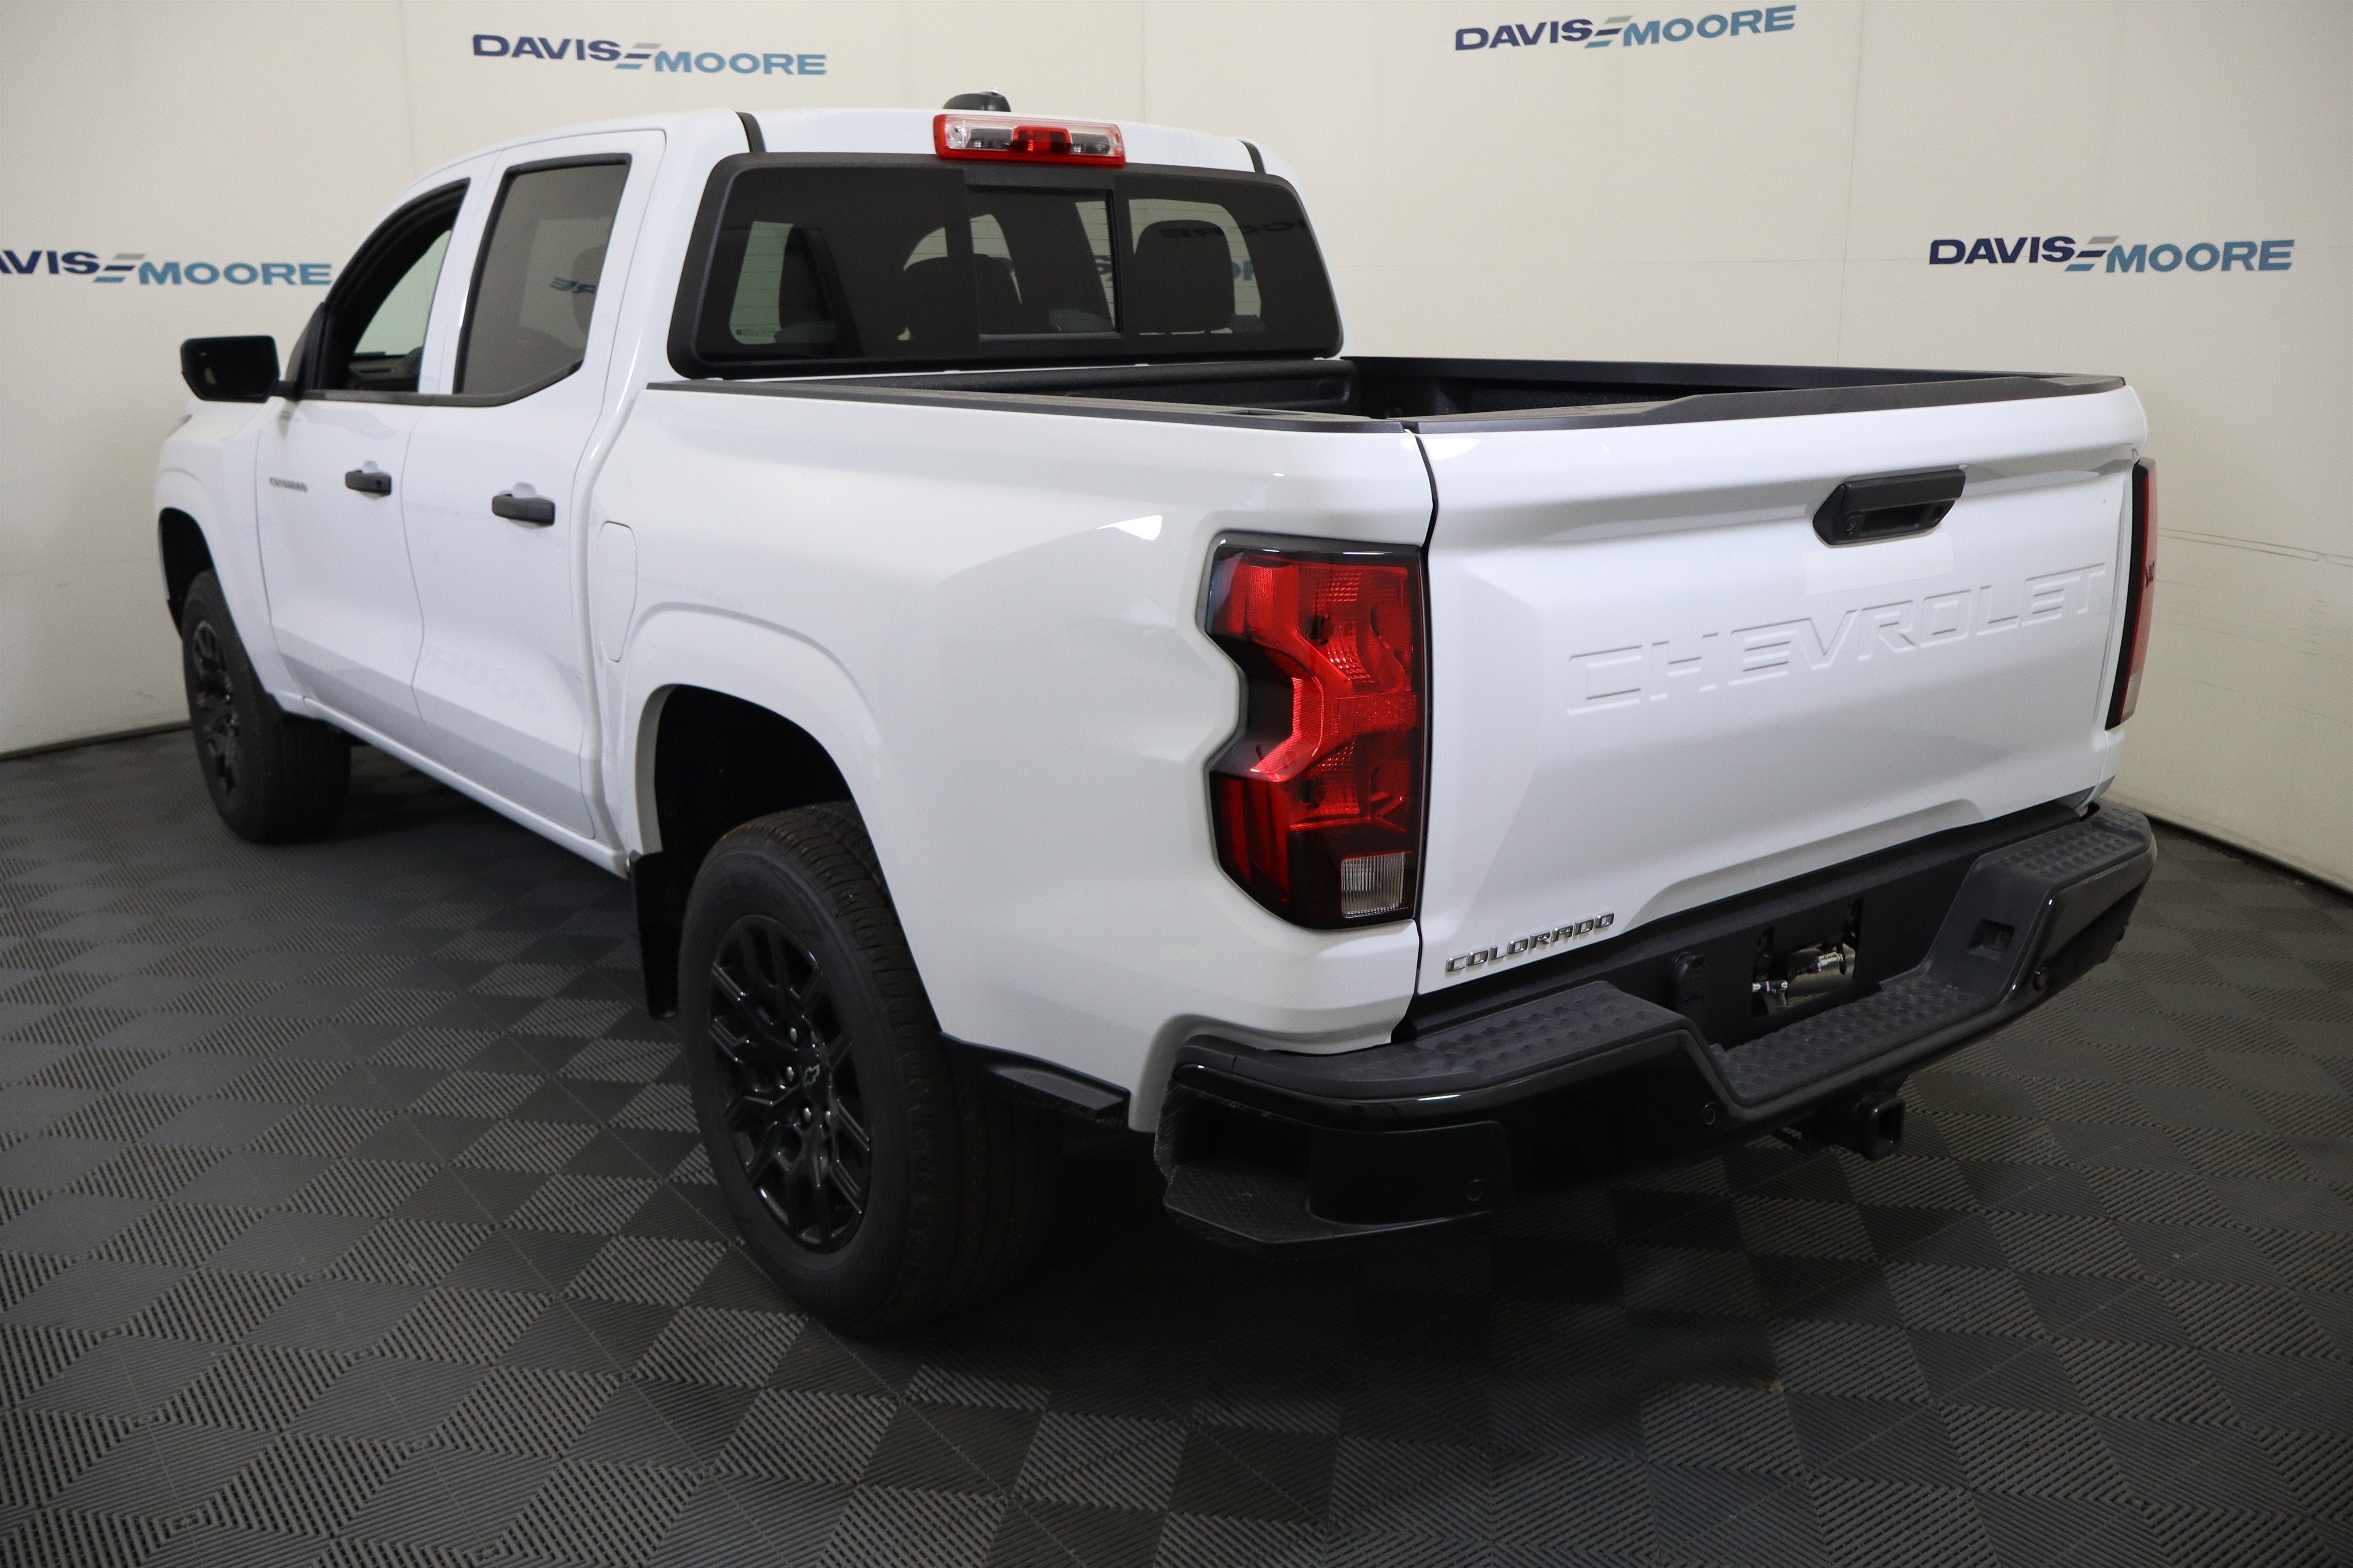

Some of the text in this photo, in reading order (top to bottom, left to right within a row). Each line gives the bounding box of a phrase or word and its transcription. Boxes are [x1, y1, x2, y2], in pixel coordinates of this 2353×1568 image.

[1455, 5, 1796, 51] DAVIS MOORE
[472, 34, 827, 75] DAVIS MOORE
[138, 262, 333, 285] MOORE
[1929, 236, 2294, 273] DAVIS MOORE
[1568, 562, 2106, 717] CHEVROLET
[1445, 912, 1615, 972] COLORADO
